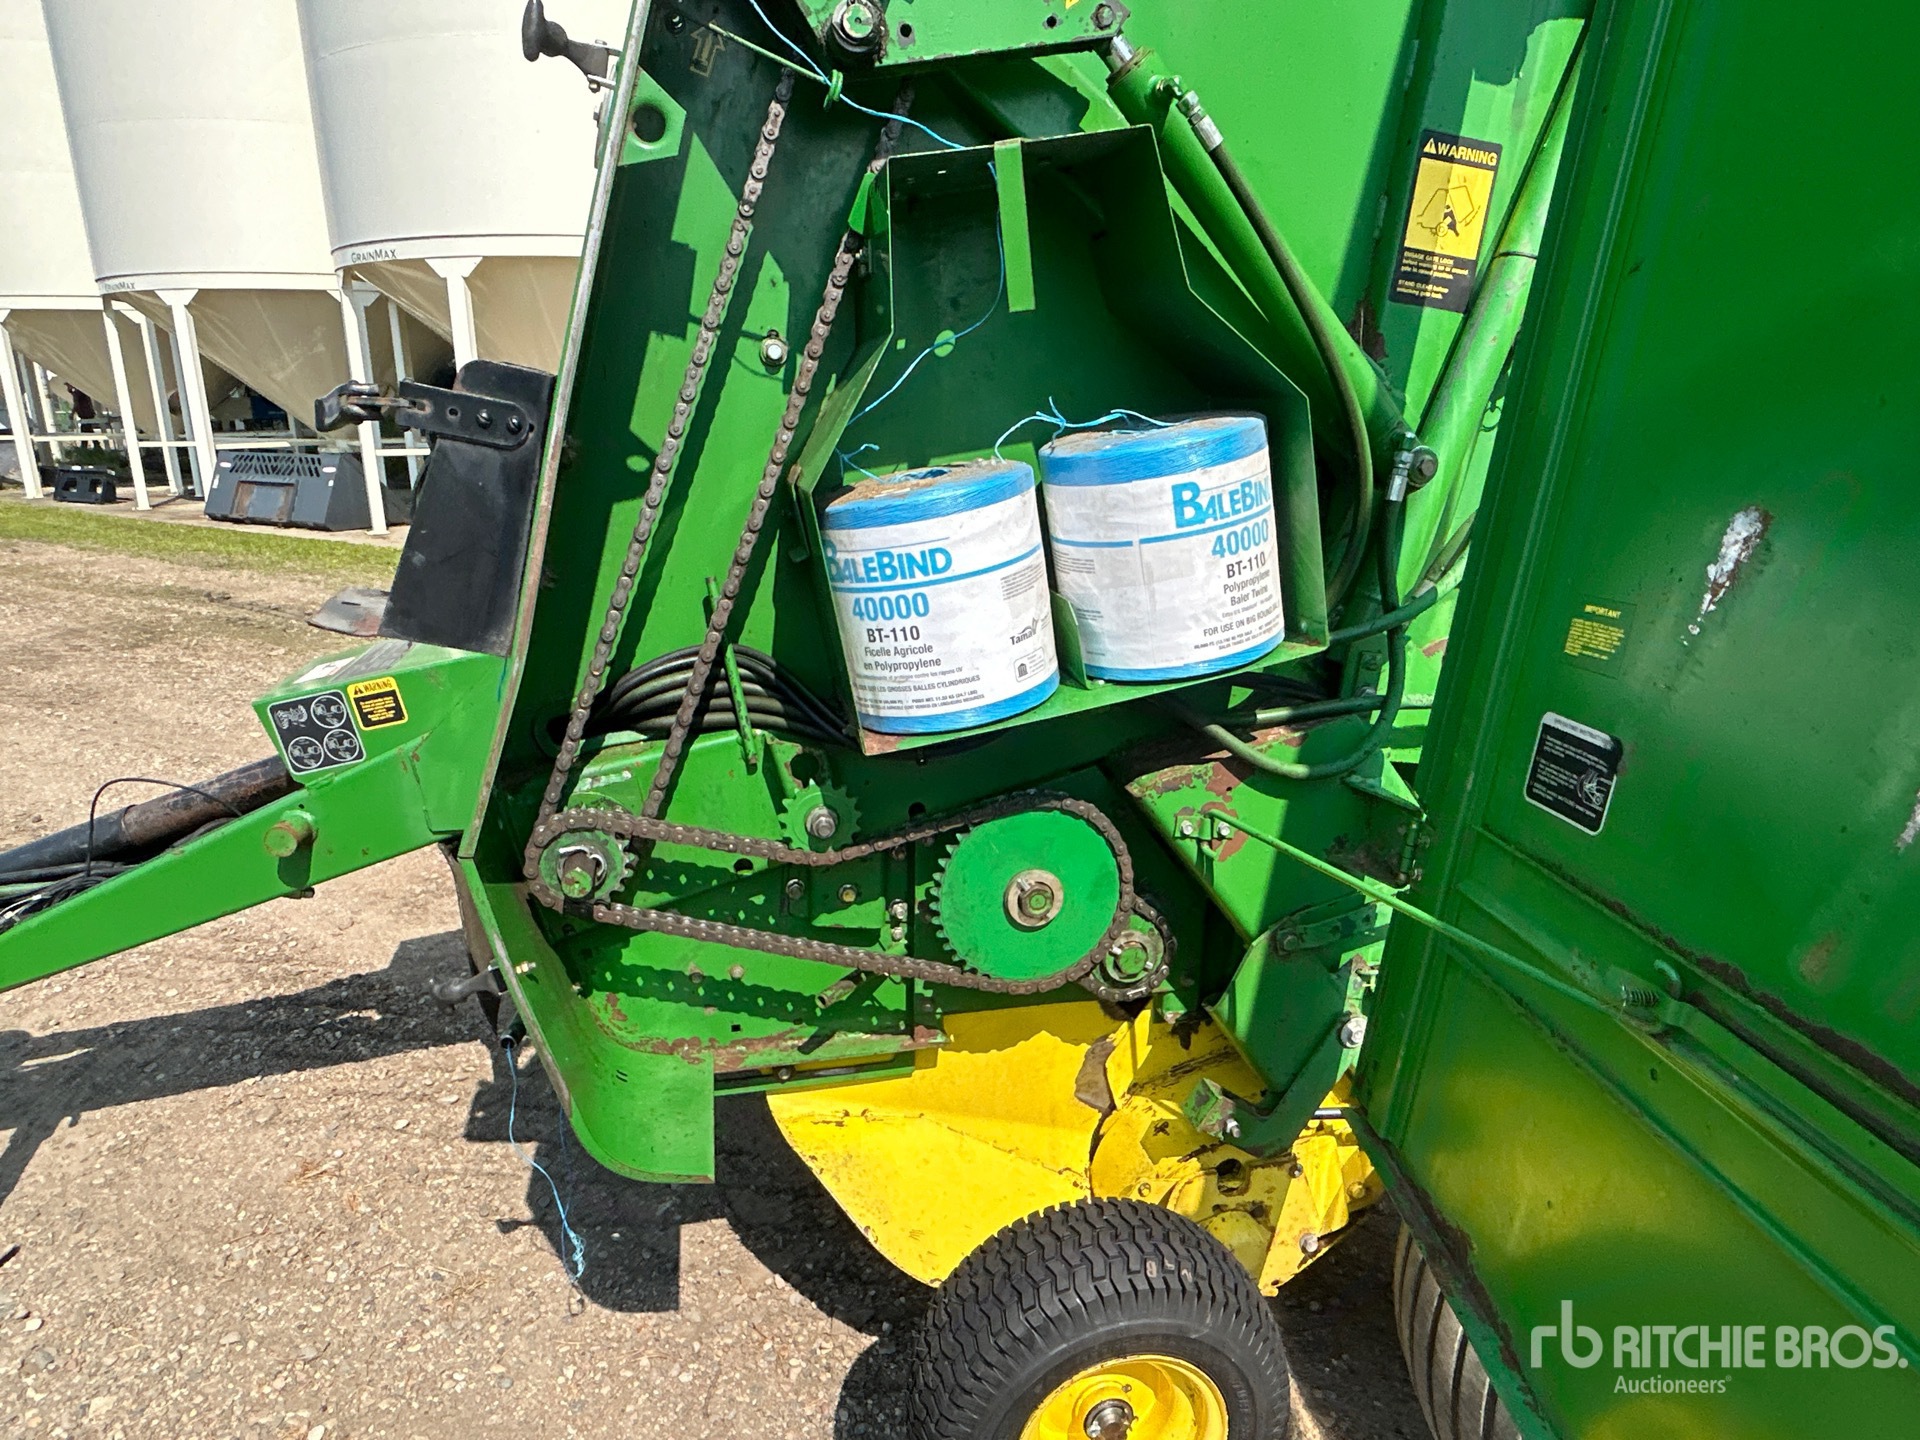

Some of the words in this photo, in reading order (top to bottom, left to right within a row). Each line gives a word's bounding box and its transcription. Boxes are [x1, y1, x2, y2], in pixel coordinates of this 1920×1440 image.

[1437, 142, 1498, 167] WARNING
[1171, 476, 1270, 529] BALEBIN
[1211, 518, 1269, 559] 40000
[1226, 551, 1266, 579] BT-110
[1223, 569, 1270, 594] Polypropylene
[852, 592, 930, 622] 40000
[1230, 592, 1250, 606] Baler
[866, 625, 920, 643] BT-110
[1203, 626, 1219, 637] FOR
[1220, 622, 1234, 633] USE
[1235, 619, 1245, 629] ON
[1246, 614, 1256, 625] BIG
[1010, 631, 1033, 645] Tama
[864, 646, 891, 657] Ficelle
[893, 643, 934, 658] Agricole
[864, 662, 873, 671] en
[875, 657, 941, 673] Polypropylene
[362, 679, 393, 693] WARNING
[913, 683, 936, 692] BALLES
[937, 675, 981, 688] CYLINDRIQUES
